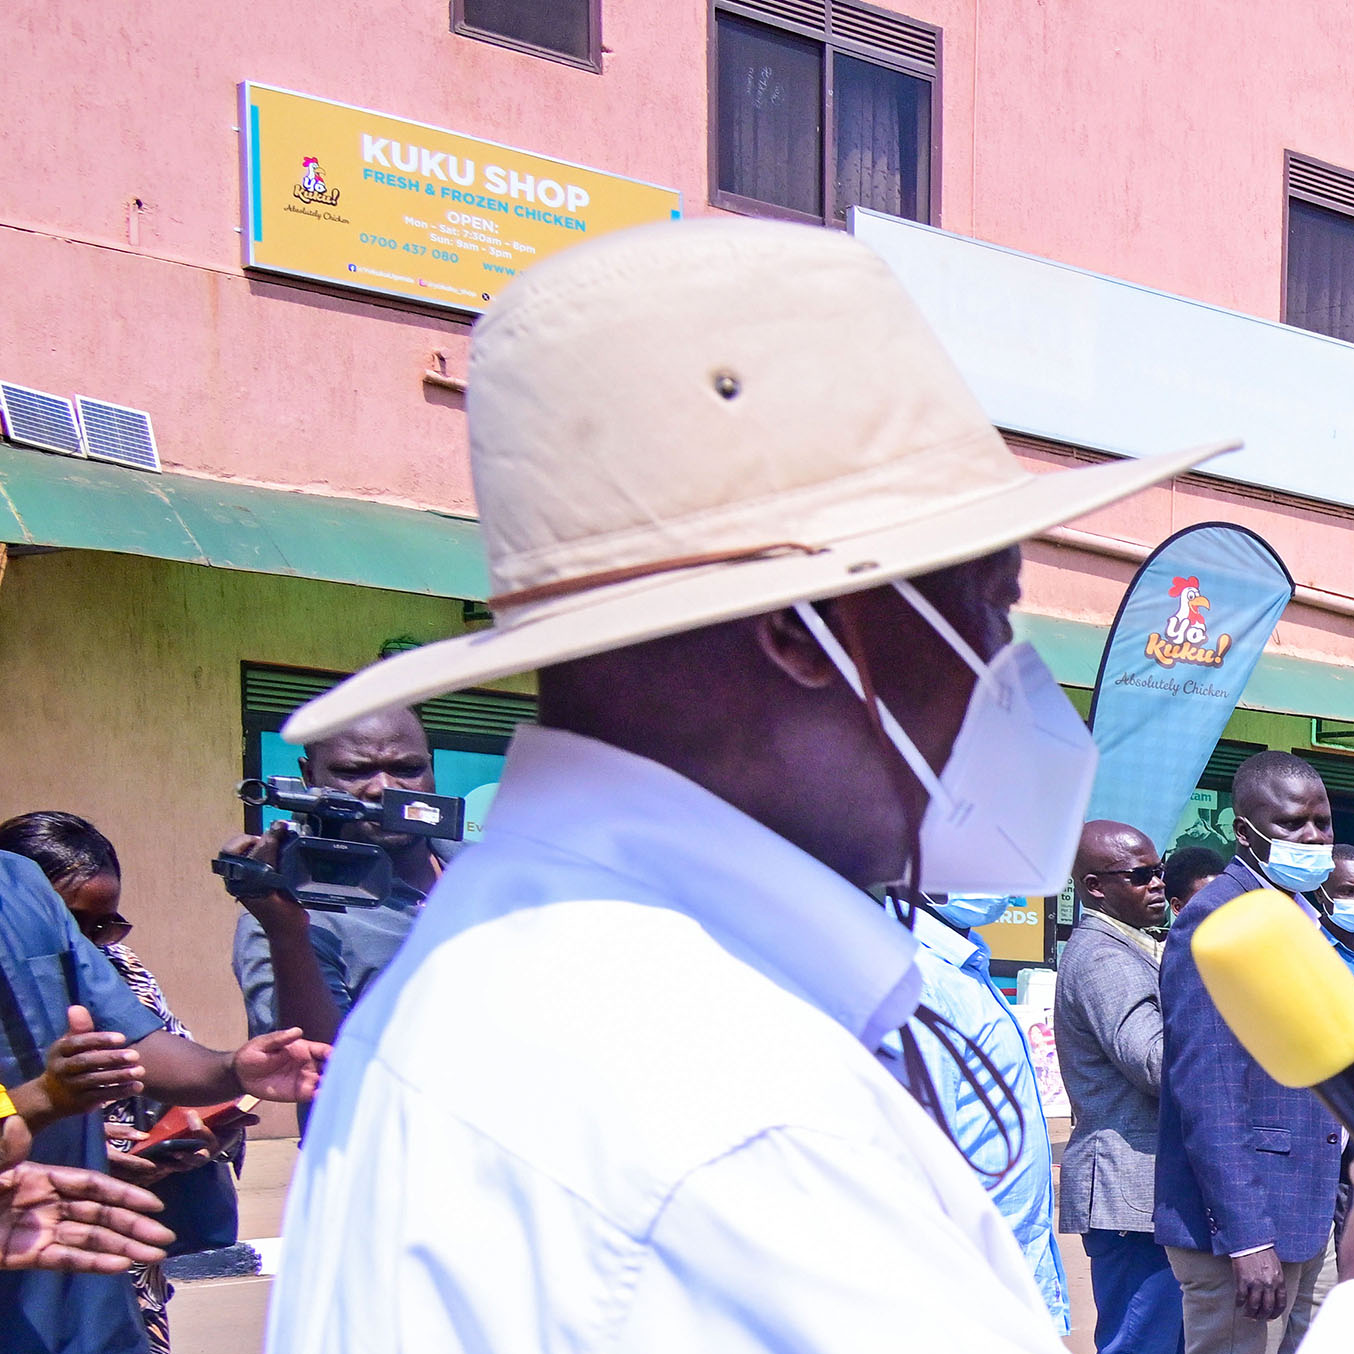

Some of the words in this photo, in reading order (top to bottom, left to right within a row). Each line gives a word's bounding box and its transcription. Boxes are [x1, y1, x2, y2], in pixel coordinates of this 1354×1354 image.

[361, 133, 476, 187] KUKU
[484, 165, 590, 214] SHOP
[363, 168, 420, 192] FRESH
[425, 184, 436, 197] &
[441, 188, 509, 213] FROZEN
[514, 205, 586, 232] CHICKEN
[404, 216, 428, 228] Mon
[439, 224, 460, 235] Sat:
[463, 229, 502, 246] 7:30am
[447, 211, 499, 234] OPEN:
[359, 232, 397, 250] 0700
[402, 242, 427, 256] 437
[431, 249, 459, 263] 080
[430, 232, 454, 245] Sun:
[456, 240, 479, 252] 9am
[1115, 672, 1180, 696] Absolutely
[1183, 680, 1229, 699] Chicken
[996, 910, 1039, 925] RDS
